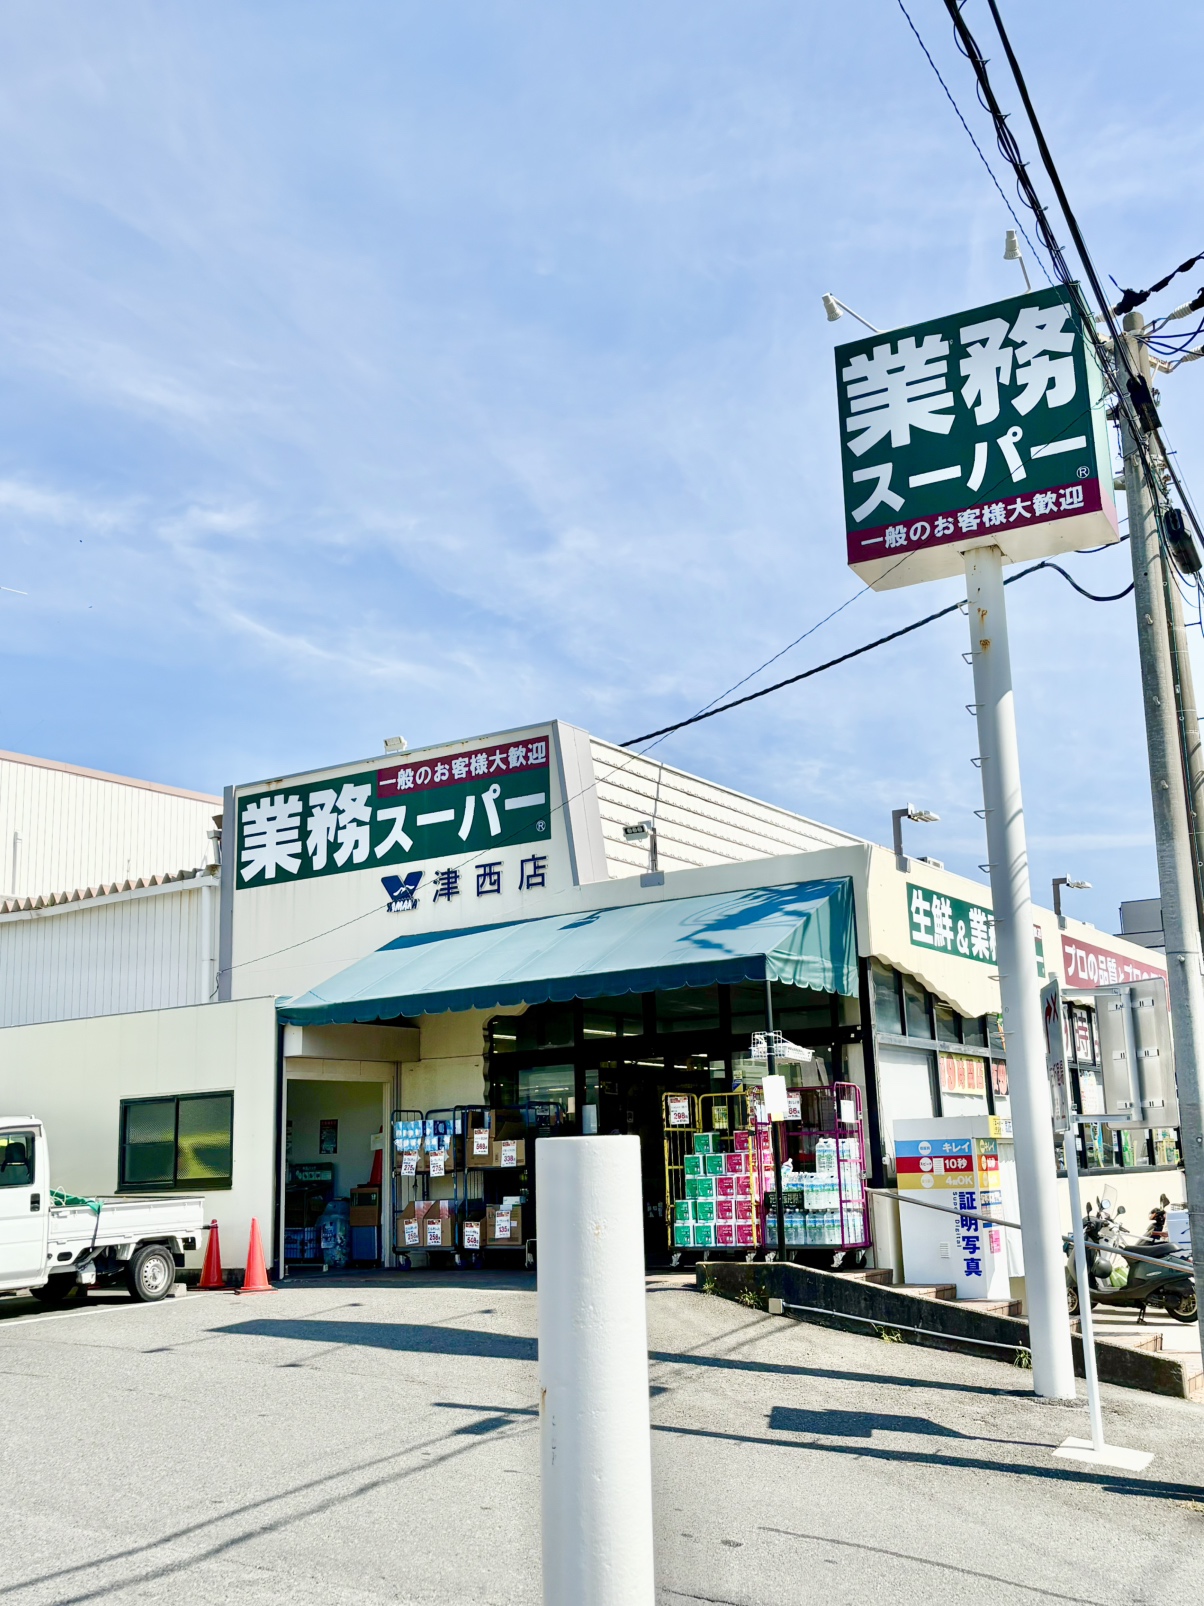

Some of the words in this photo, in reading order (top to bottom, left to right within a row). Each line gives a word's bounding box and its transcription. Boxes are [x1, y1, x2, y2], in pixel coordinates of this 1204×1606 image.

[842, 302, 1077, 457] 業務
[851, 425, 1087, 523] スーパー
[861, 485, 1085, 550] 一般のお客様大歓迎
[379, 741, 547, 791] 一般のお客様大歓迎
[433, 854, 548, 902] 津西店
[942, 1141, 970, 1153] キレイ
[944, 1158, 968, 1169] 10秒
[959, 1191, 982, 1277] 証明写真
